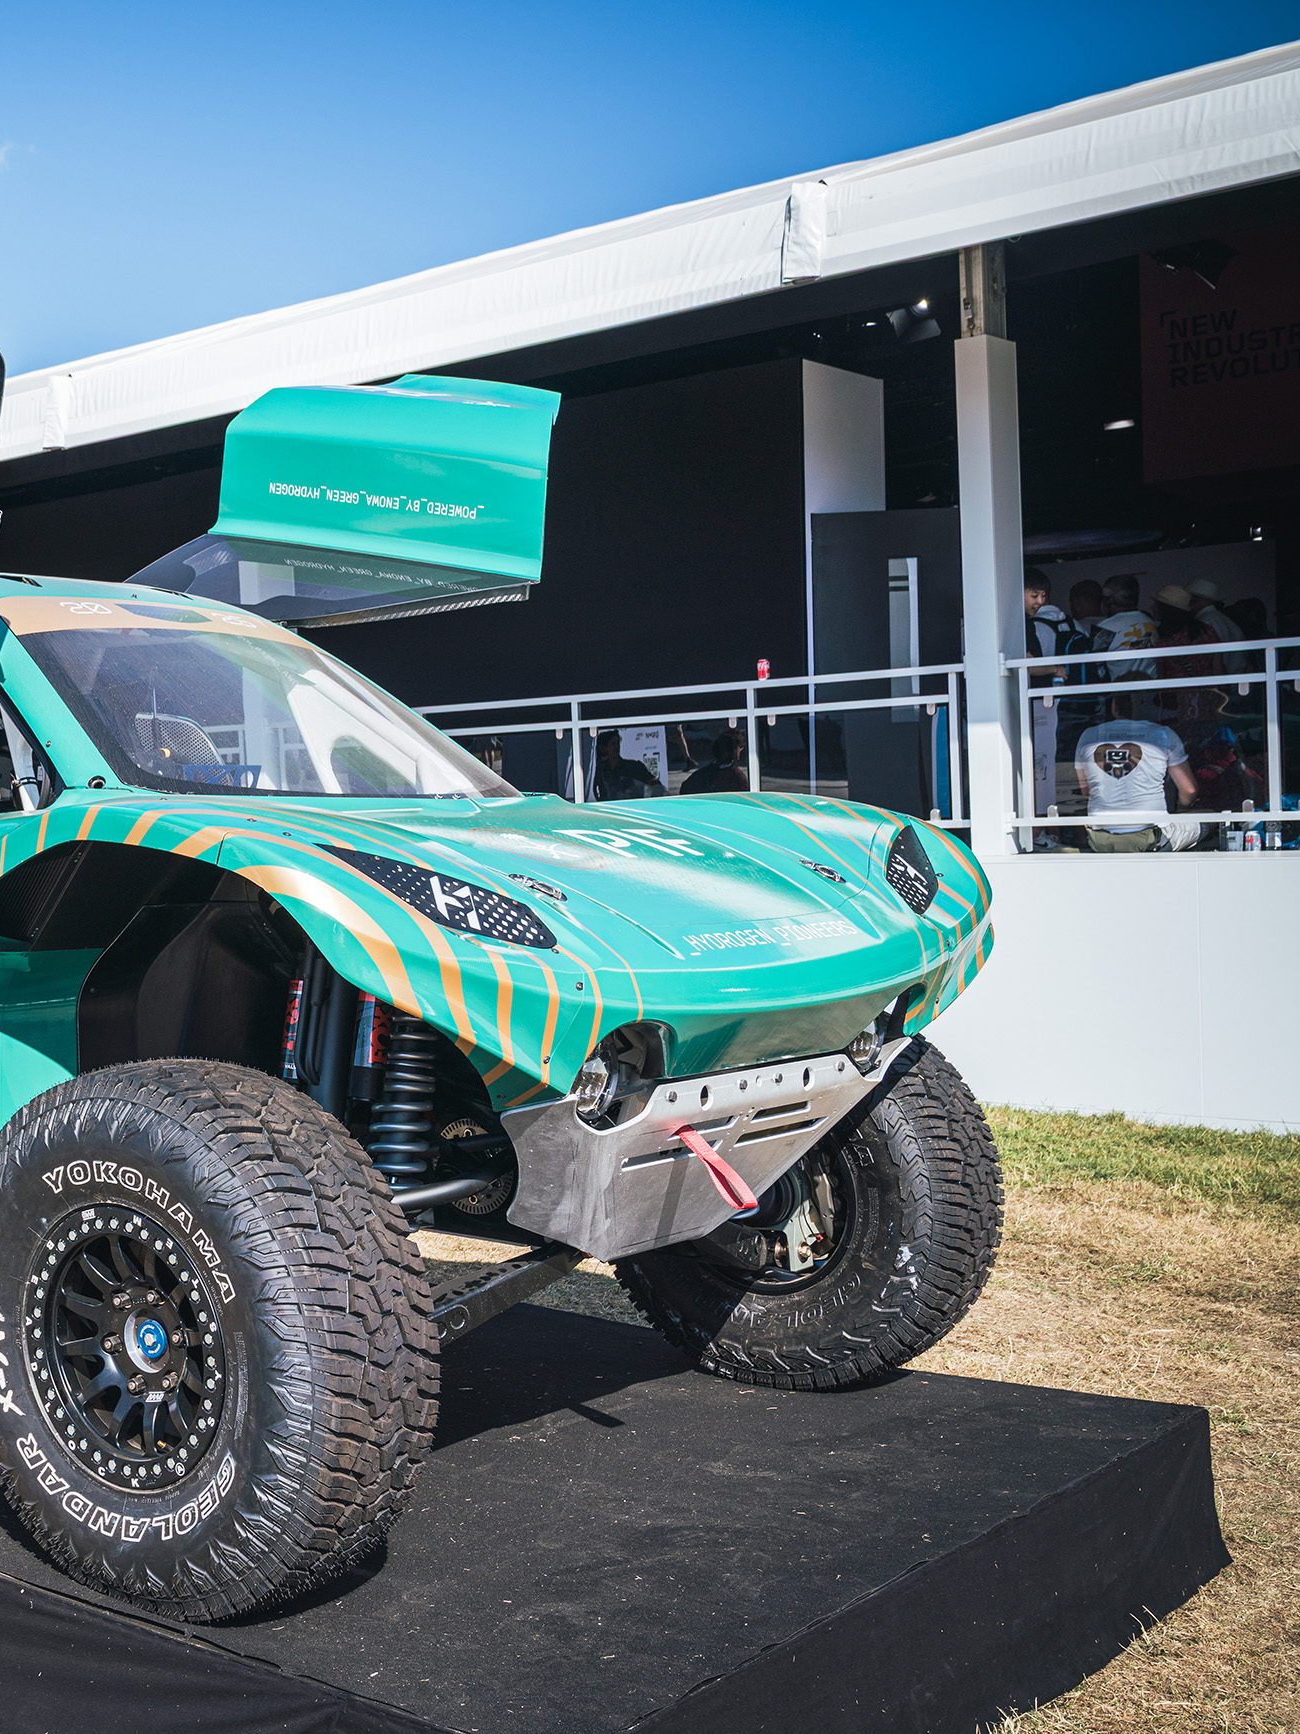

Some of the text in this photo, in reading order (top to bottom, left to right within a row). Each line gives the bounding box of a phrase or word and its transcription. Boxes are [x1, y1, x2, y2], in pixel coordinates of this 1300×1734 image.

[1169, 309, 1237, 340] NEW
[368, 1005, 392, 1065] FOX
[42, 1160, 236, 1304] YOKOHAMA
[16, 1432, 237, 1542] GEOLANDAR
